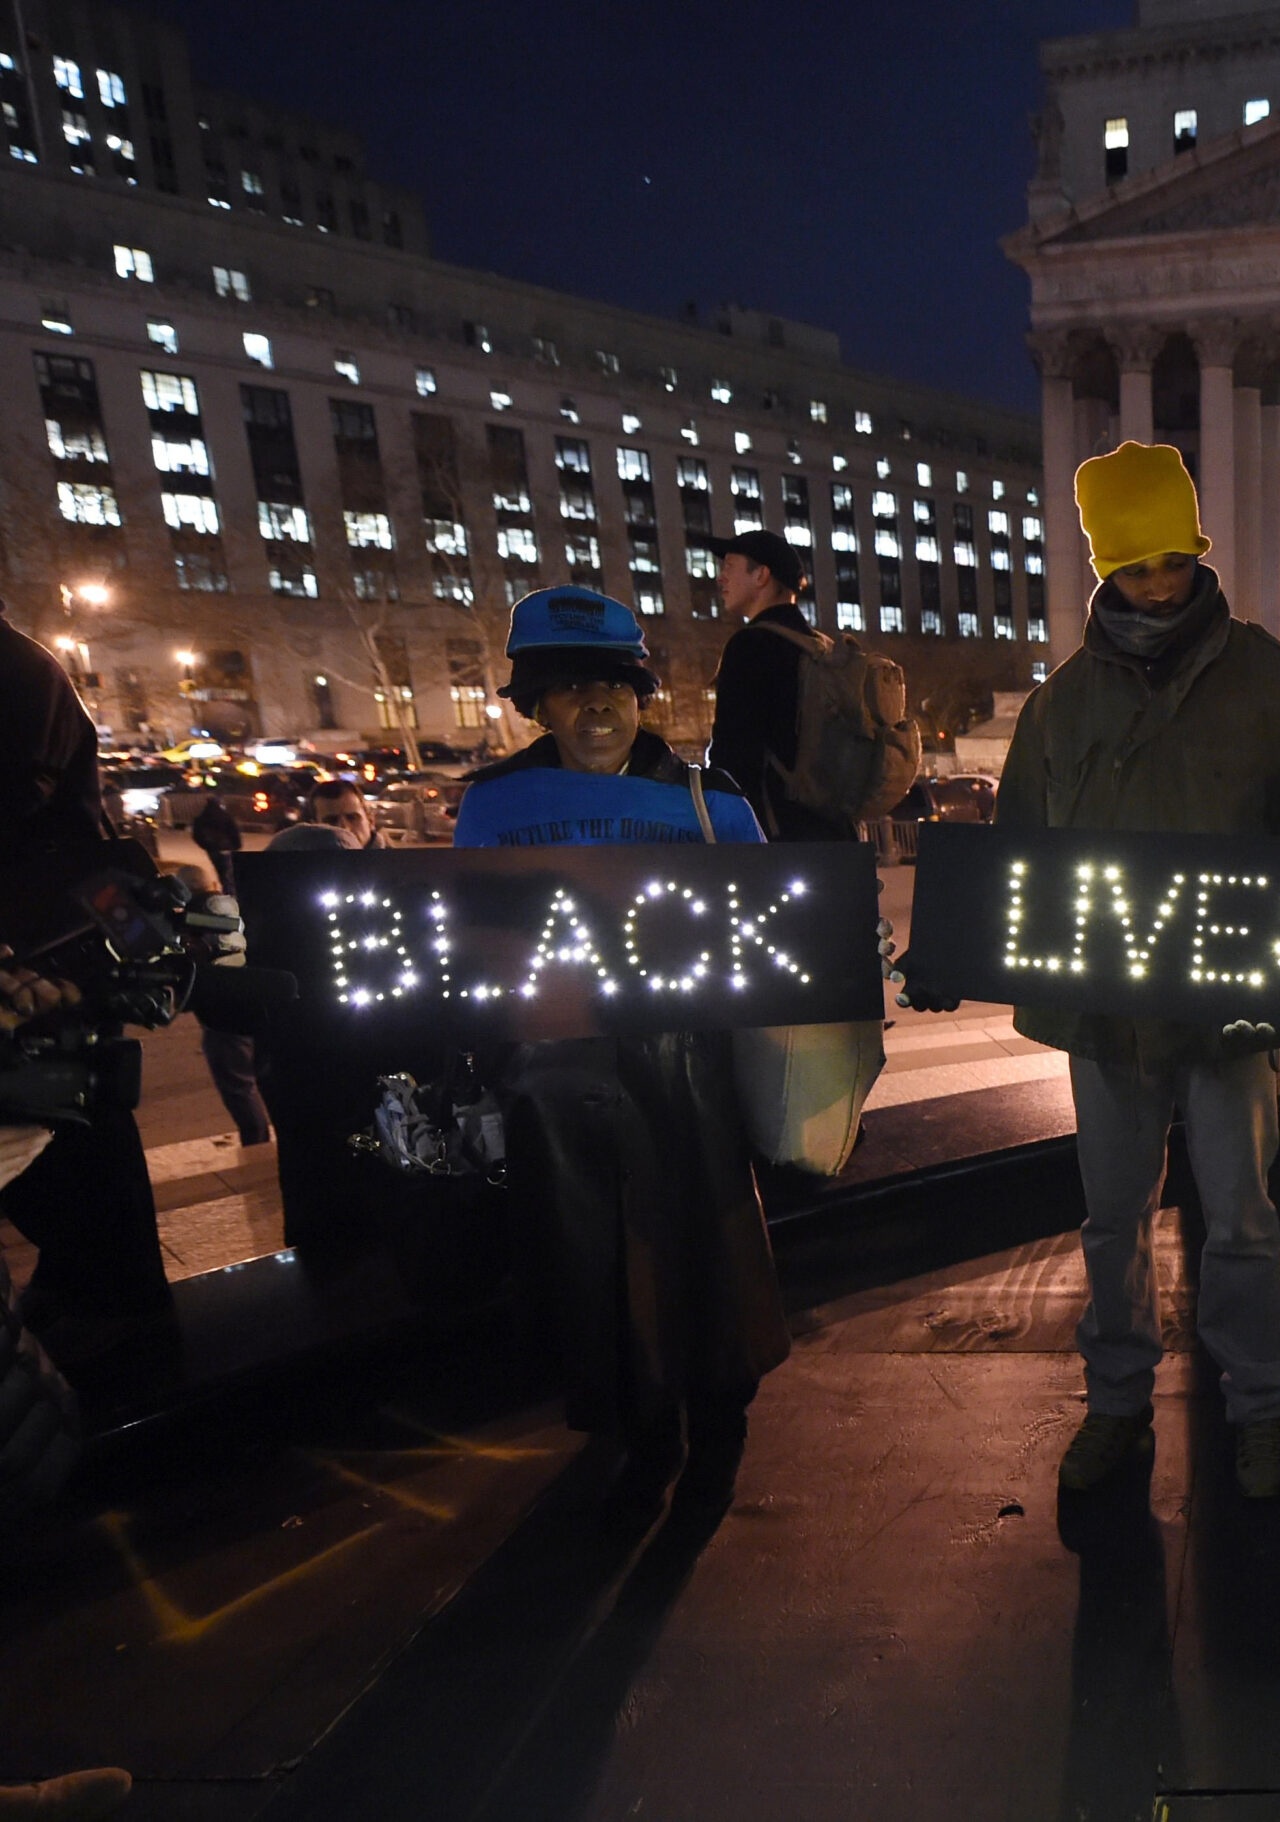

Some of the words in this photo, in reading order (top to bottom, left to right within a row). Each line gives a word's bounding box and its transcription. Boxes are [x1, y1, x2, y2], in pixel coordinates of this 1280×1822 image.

[498, 820, 572, 846] PICTURE
[578, 818, 614, 838] THE
[318, 880, 811, 1008] BLACK
